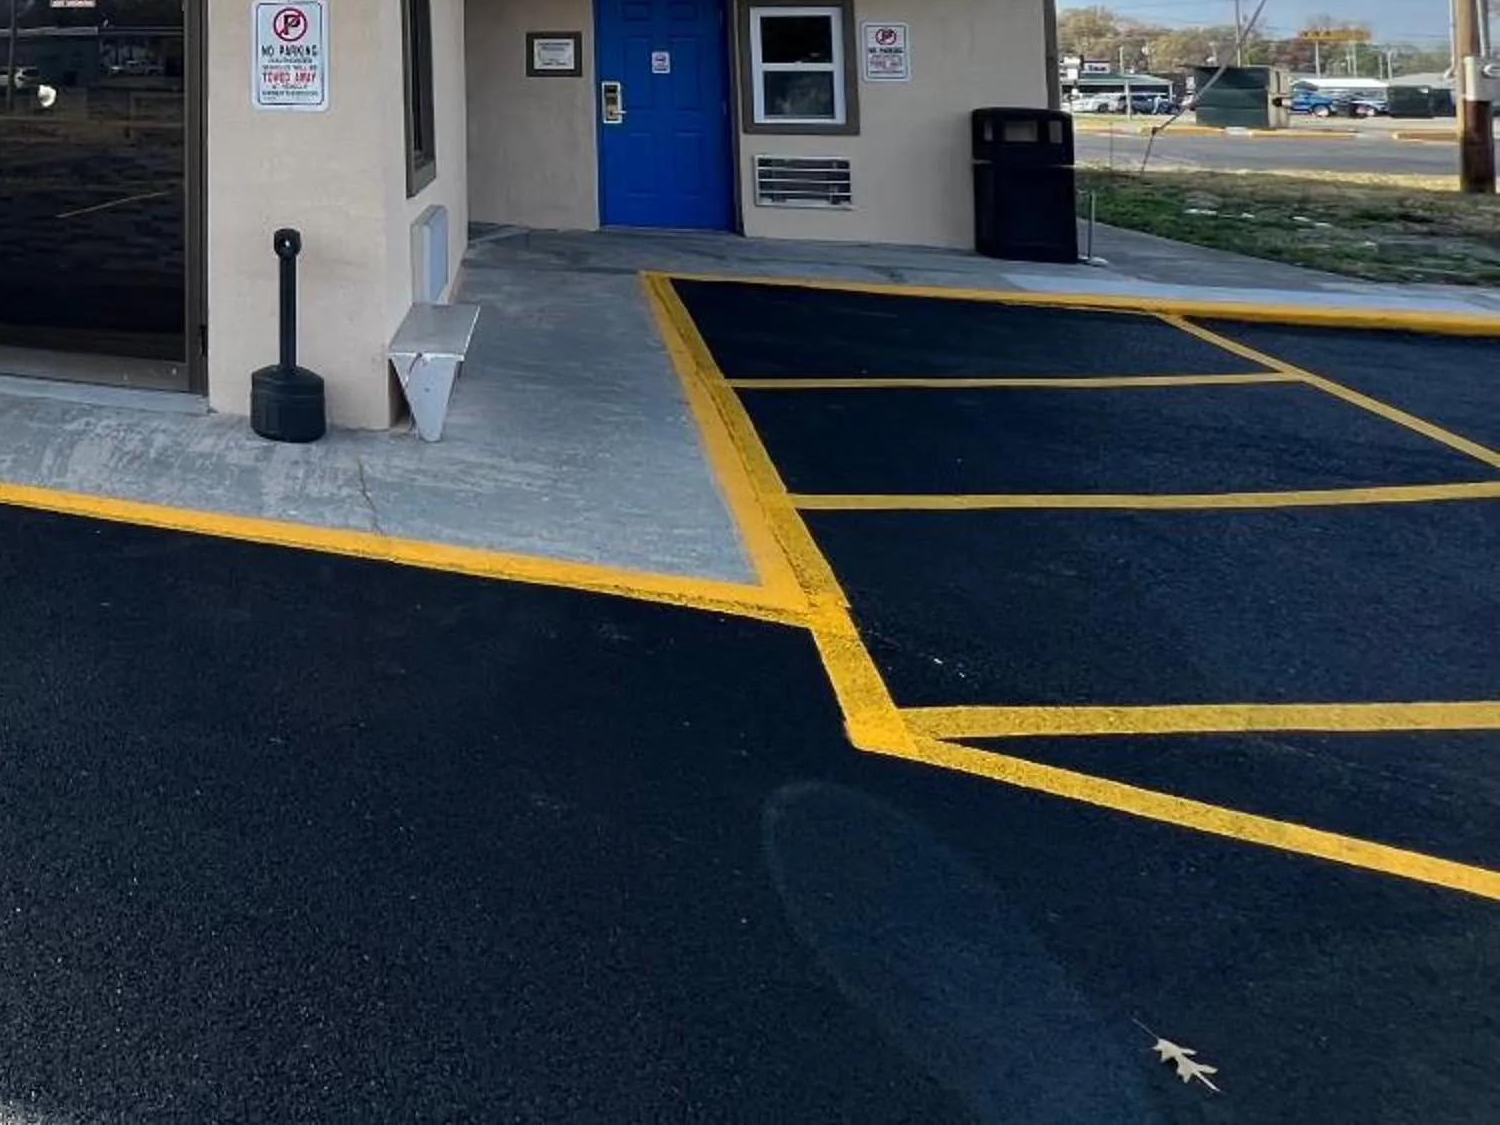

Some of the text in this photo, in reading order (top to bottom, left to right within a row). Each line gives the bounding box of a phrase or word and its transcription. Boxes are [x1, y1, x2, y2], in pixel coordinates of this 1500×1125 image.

[261, 44, 318, 57] NO PARKING
[262, 71, 317, 83] TOWED AWAY
